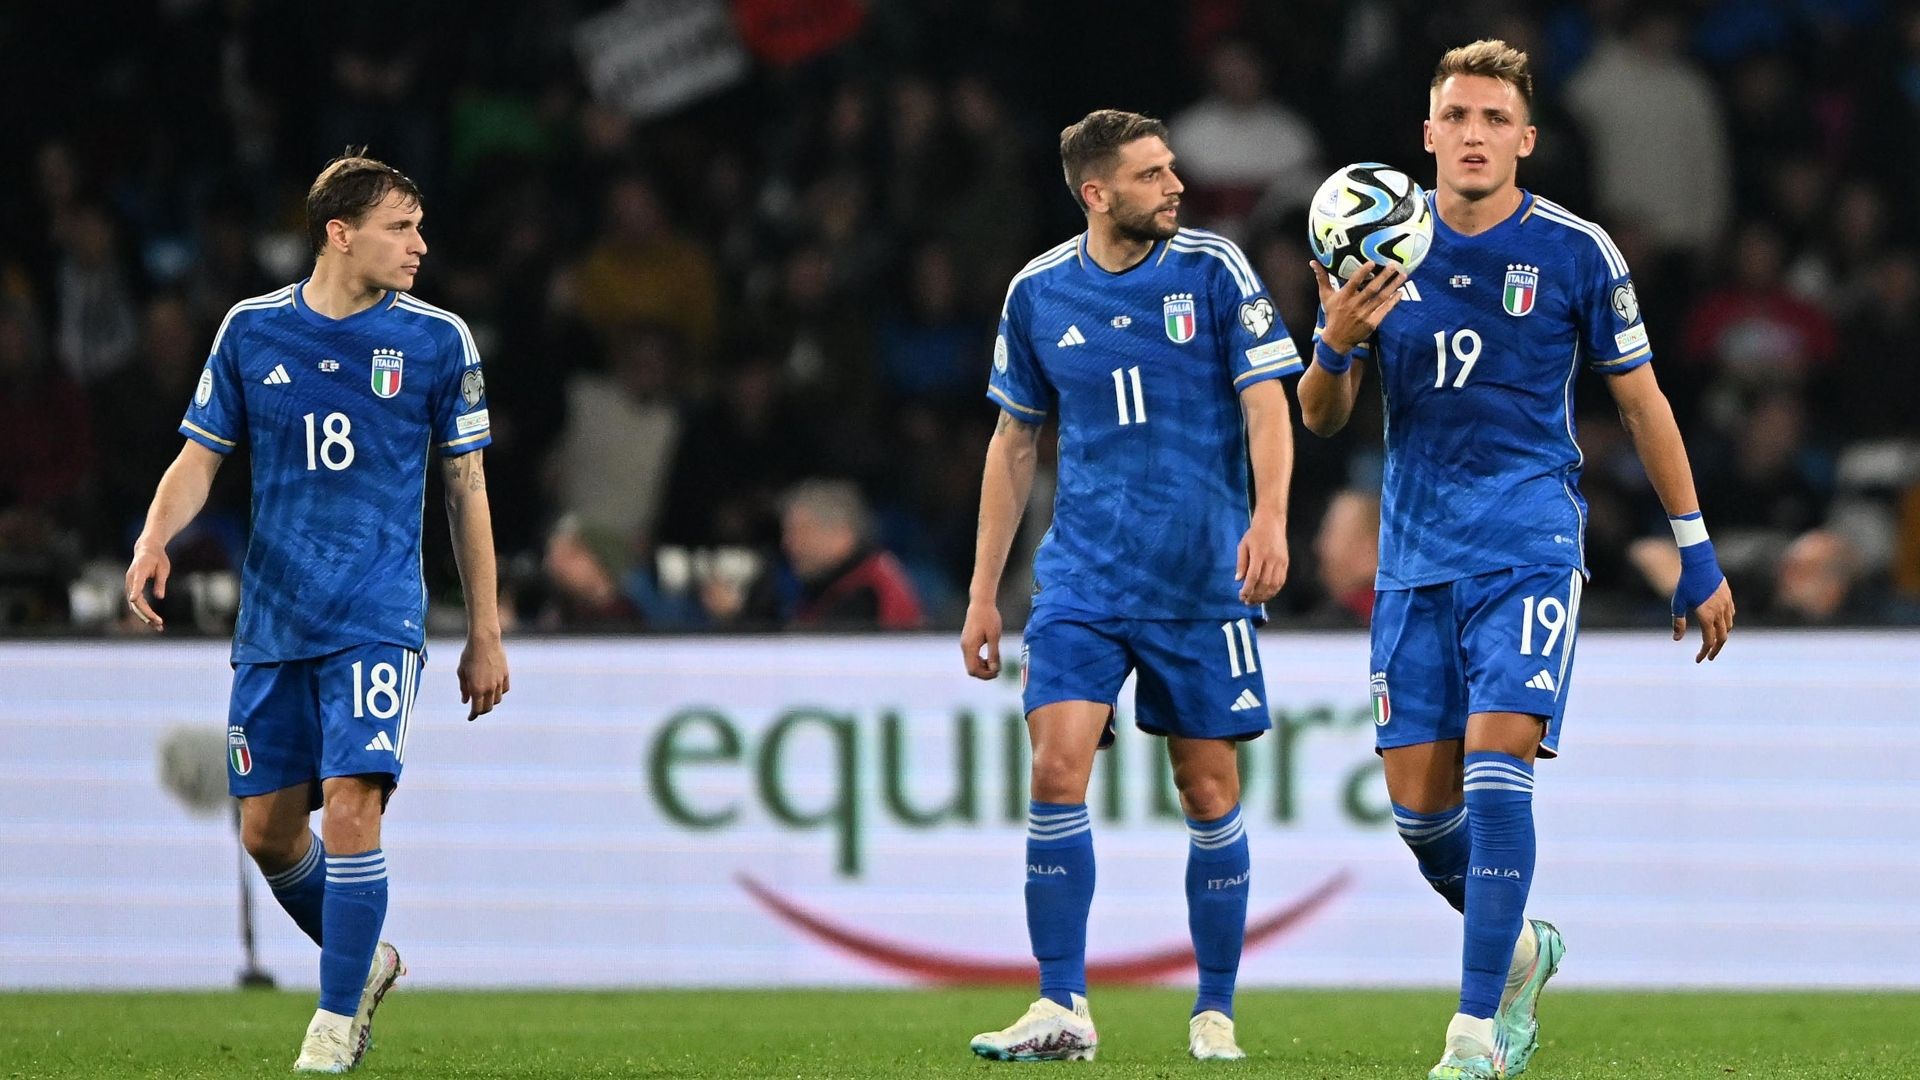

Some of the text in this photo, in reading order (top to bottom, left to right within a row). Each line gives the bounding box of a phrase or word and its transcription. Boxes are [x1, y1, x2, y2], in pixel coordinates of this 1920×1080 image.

[1167, 303, 1191, 314] ITALIA
[1508, 274, 1534, 285] ITALIA
[375, 359, 400, 369] ITALIA
[1433, 329, 1482, 388] 19
[1111, 365, 1147, 425] 11
[303, 412, 355, 471] 18
[1221, 618, 1257, 678] 11
[1520, 596, 1566, 657] 19
[352, 660, 400, 719] 18
[646, 662, 1392, 877] equiira
[1026, 864, 1067, 875] ALIA
[1472, 866, 1520, 879] ITALIA
